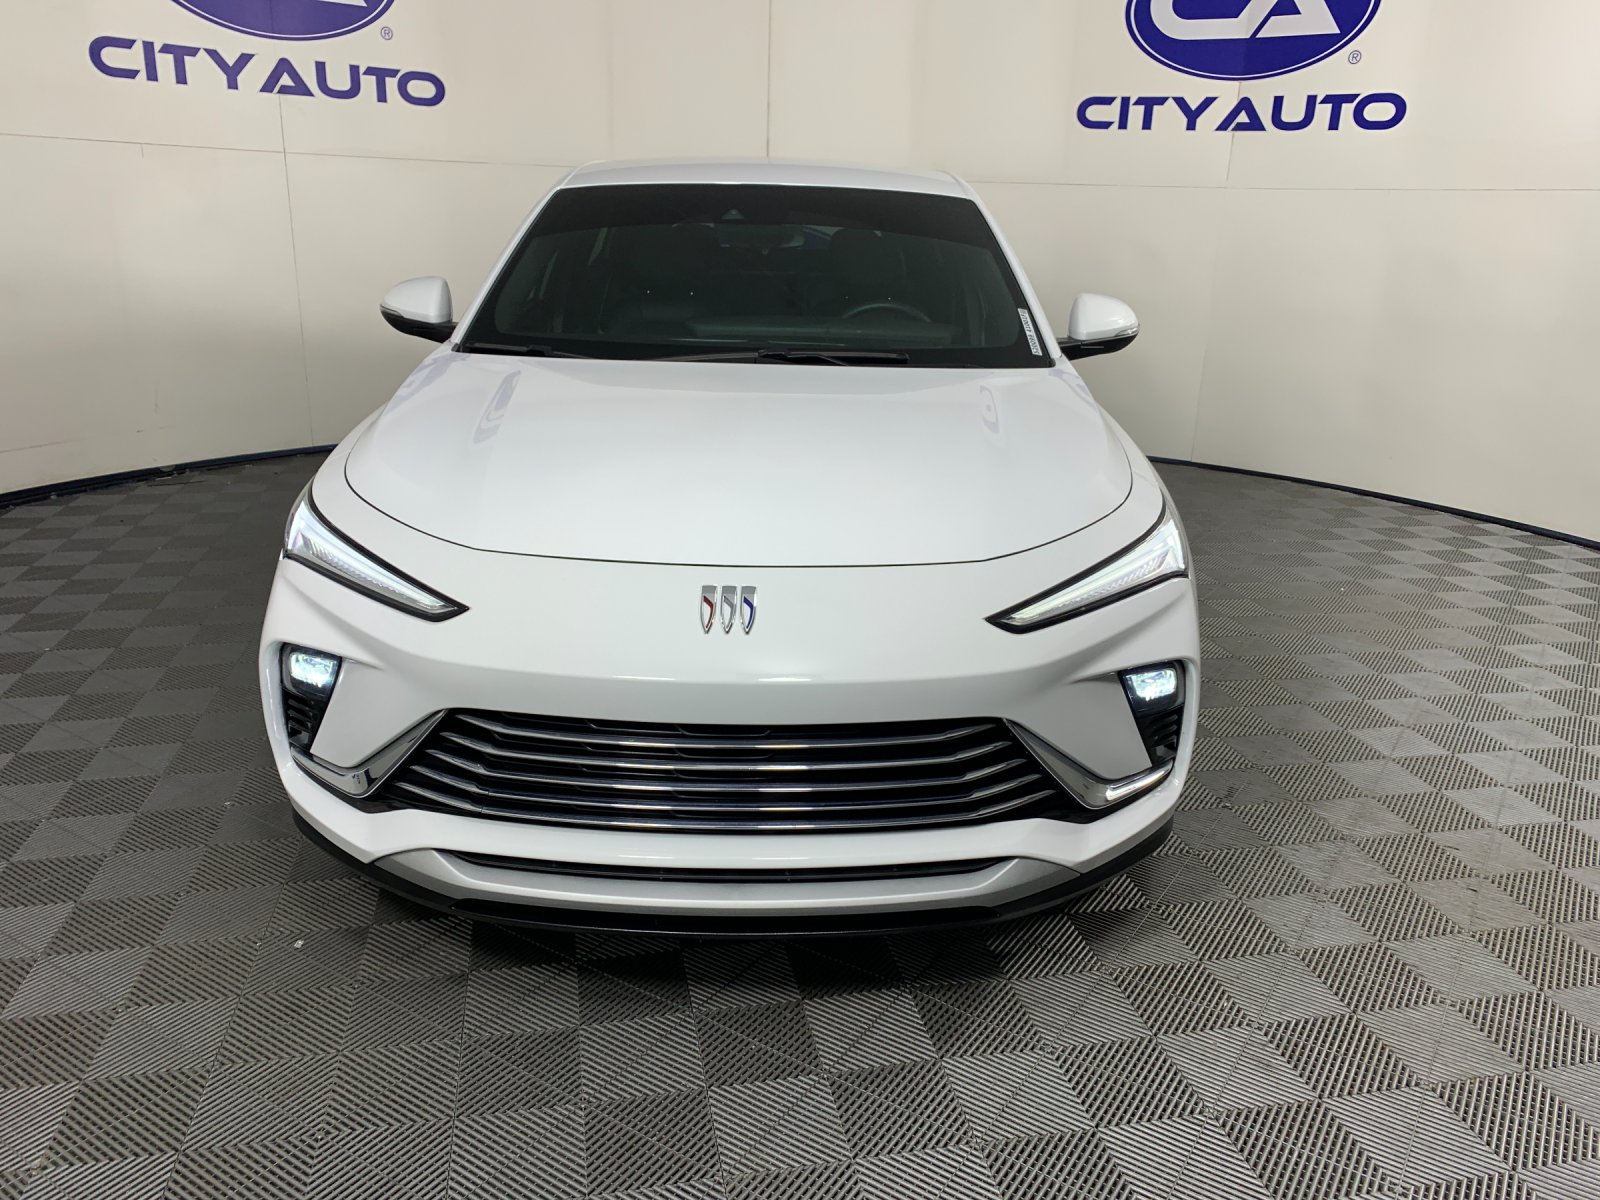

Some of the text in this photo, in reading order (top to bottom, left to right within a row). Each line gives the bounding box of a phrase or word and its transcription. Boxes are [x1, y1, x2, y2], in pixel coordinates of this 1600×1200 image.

[88, 35, 447, 107] CITY AUTO
[1076, 92, 1408, 132] CITY AUTO
